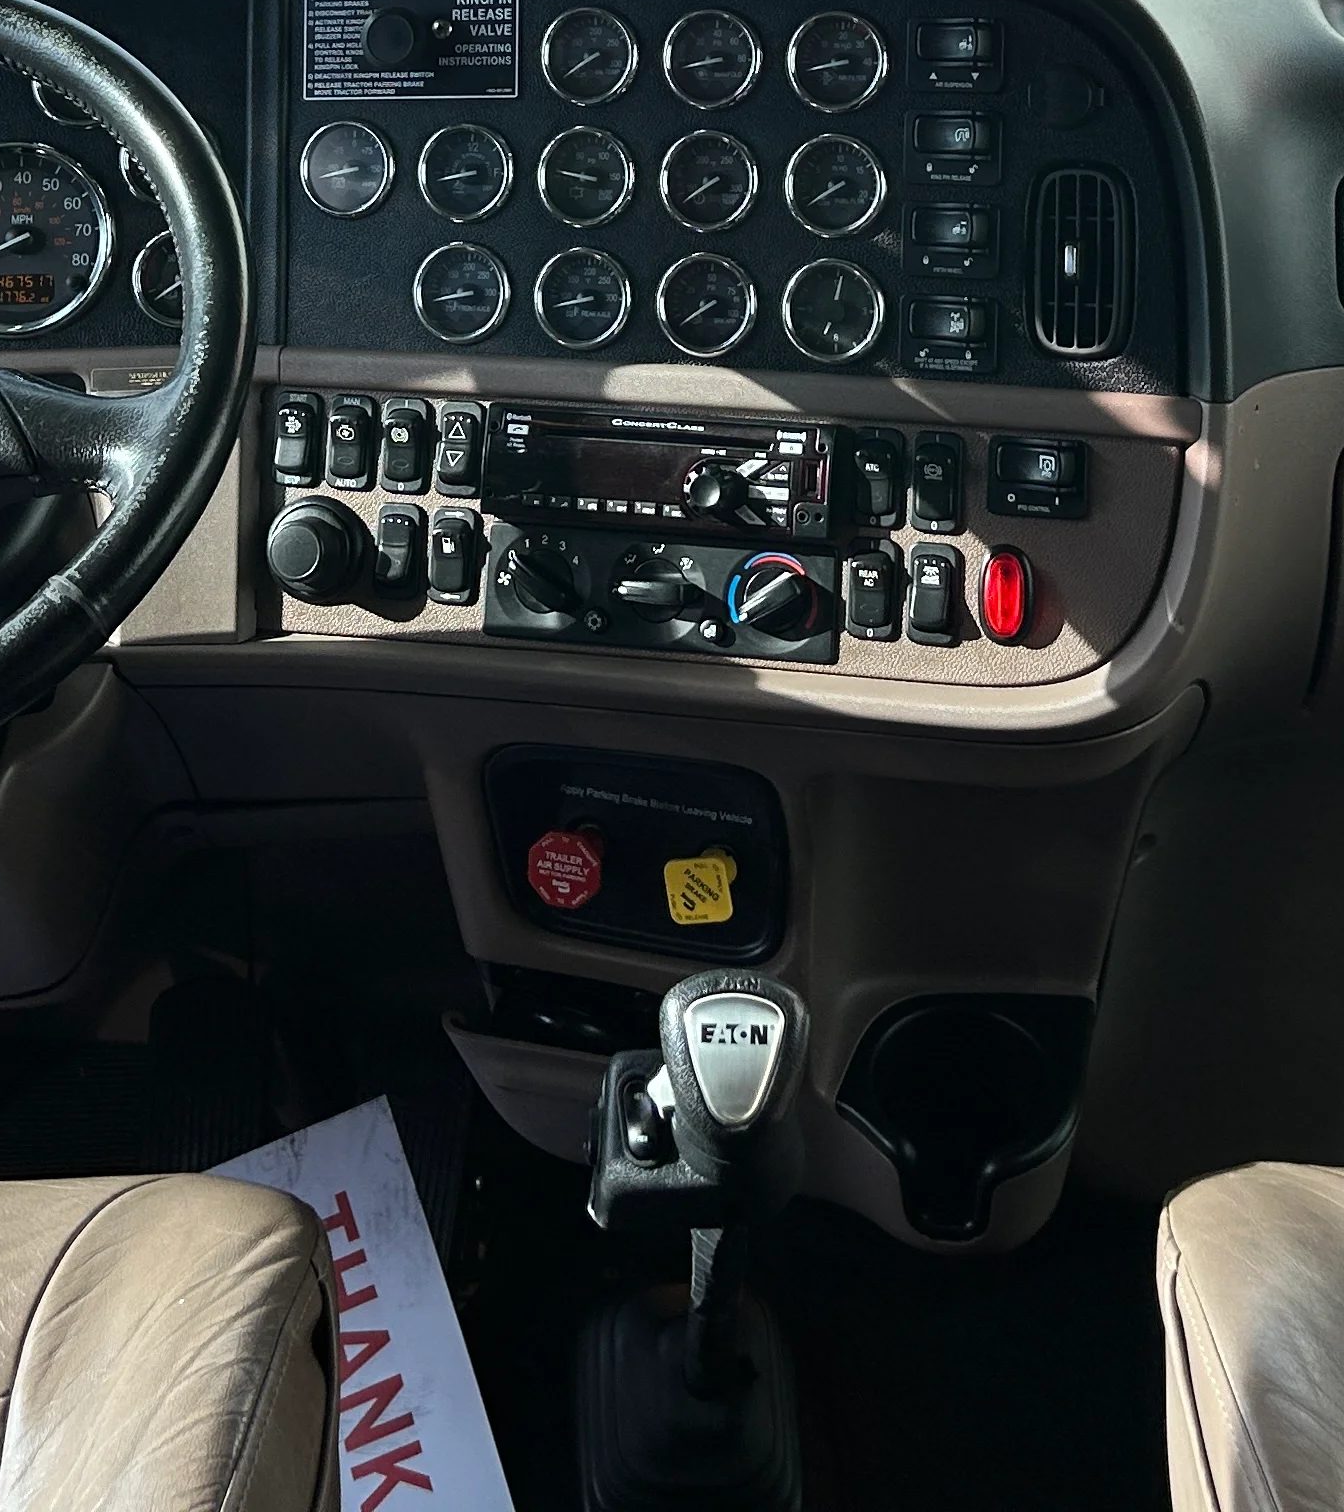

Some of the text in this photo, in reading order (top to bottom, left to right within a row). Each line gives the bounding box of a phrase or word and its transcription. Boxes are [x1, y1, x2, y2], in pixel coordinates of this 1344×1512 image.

[452, 8, 513, 21] RELEASE
[469, 24, 513, 37] VALVE
[455, 43, 512, 54] OPERATING
[438, 56, 512, 66] INSTRUCTIONS
[14, 171, 31, 184] 40
[42, 178, 59, 191] 50
[63, 197, 81, 210] 60
[11, 214, 33, 225] MPH
[74, 224, 91, 236] 70
[72, 253, 89, 266] 80
[344, 397, 360, 405] MAN
[865, 463, 879, 472] ATC
[335, 479, 356, 487] AUTO
[524, 539, 530, 548] 1
[542, 534, 549, 544] 2
[559, 541, 566, 550] 3
[572, 555, 579, 565] 4
[859, 570, 879, 579] REAR
[864, 579, 874, 587] AC
[586, 787, 620, 804] Parking
[621, 793, 648, 808] Brake
[649, 799, 681, 813] Before
[682, 804, 717, 821] Leaving
[719, 810, 753, 825] Vehicle
[545, 850, 583, 866] TRAILER
[537, 859, 590, 876] AIR SUPPLY
[684, 868, 720, 901] PARKING
[685, 882, 707, 903] BRAKE
[700, 1022, 769, 1045] EATON
[323, 1190, 434, 1512] THANK
